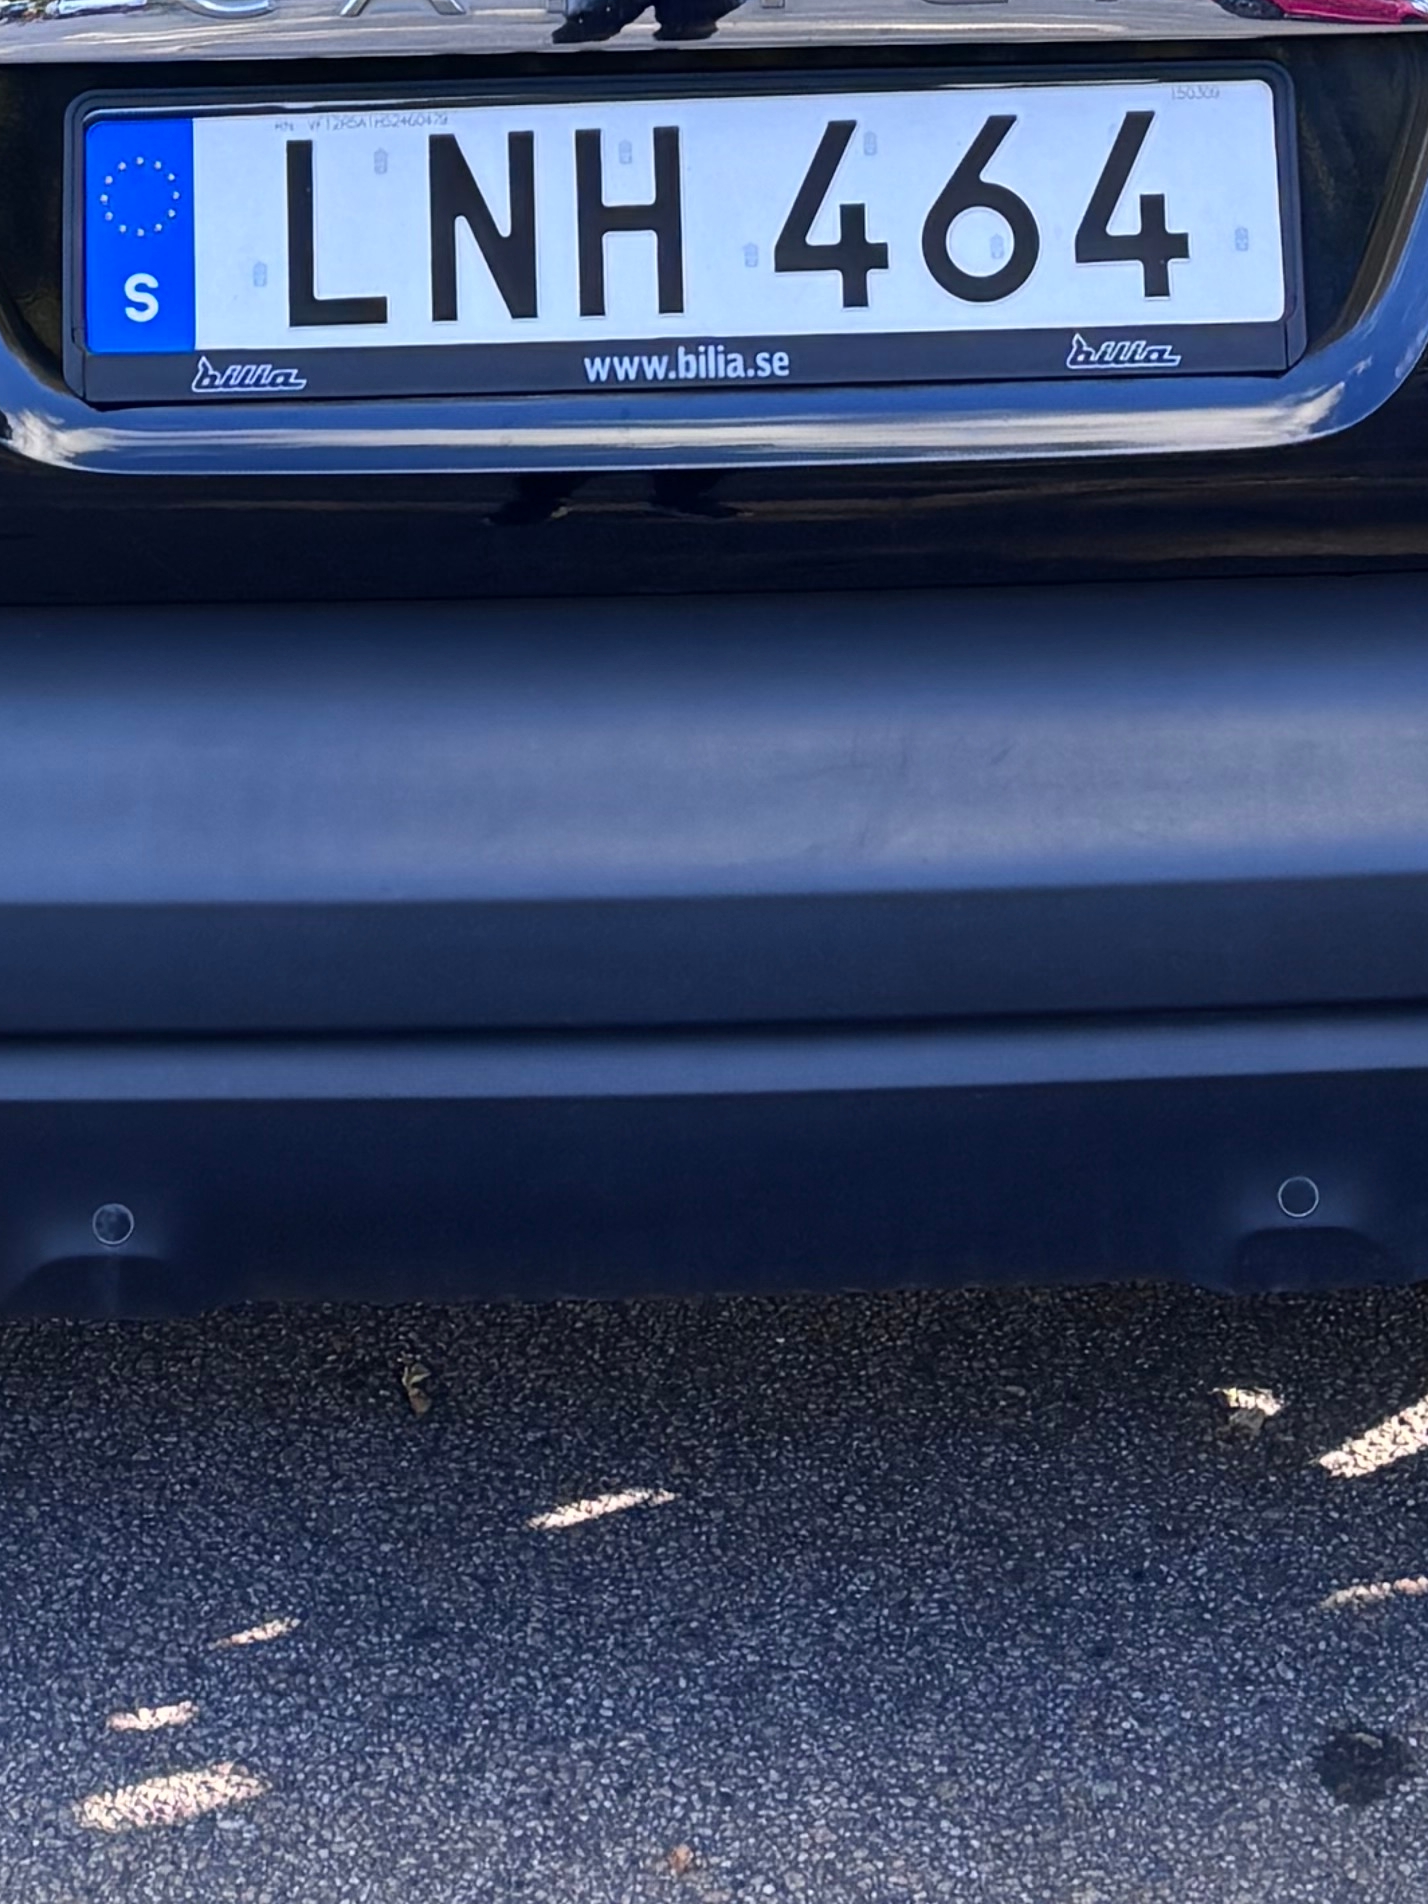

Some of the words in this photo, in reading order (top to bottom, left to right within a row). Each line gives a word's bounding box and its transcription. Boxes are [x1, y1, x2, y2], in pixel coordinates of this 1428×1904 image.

[286, 126, 684, 327] LNH
[774, 110, 1189, 308] 464
[124, 273, 160, 323] S
[583, 345, 790, 383] www.bilia.se
